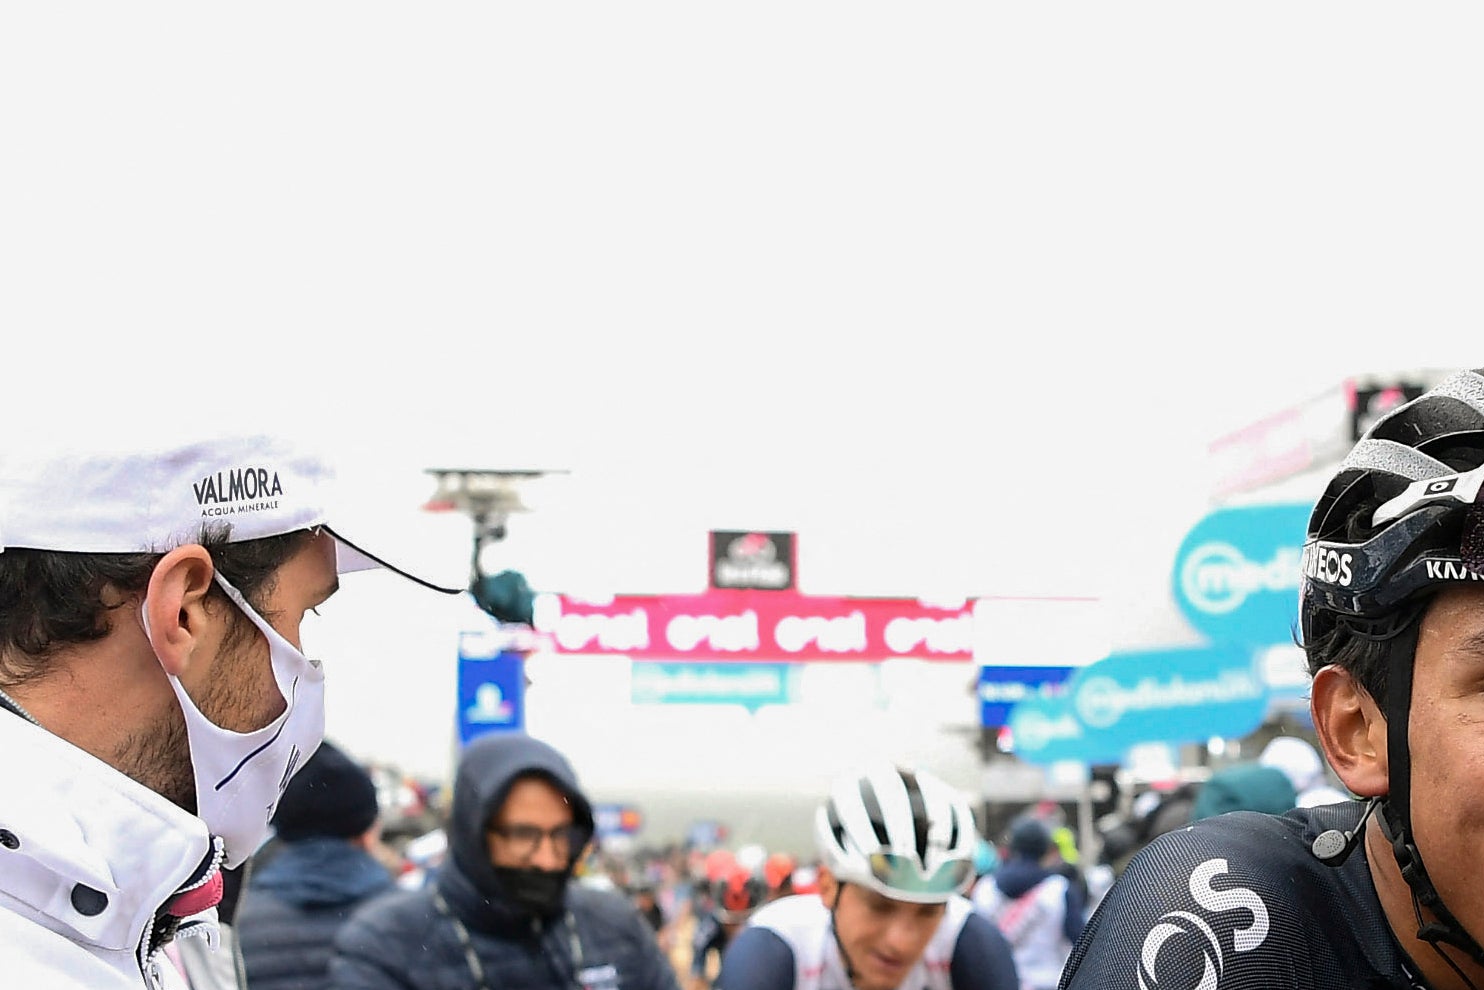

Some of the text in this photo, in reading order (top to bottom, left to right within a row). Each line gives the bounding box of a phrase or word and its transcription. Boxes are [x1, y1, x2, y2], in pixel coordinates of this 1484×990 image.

[192, 467, 283, 505] VALMORA
[201, 500, 279, 518] ACQUA MINERALE
